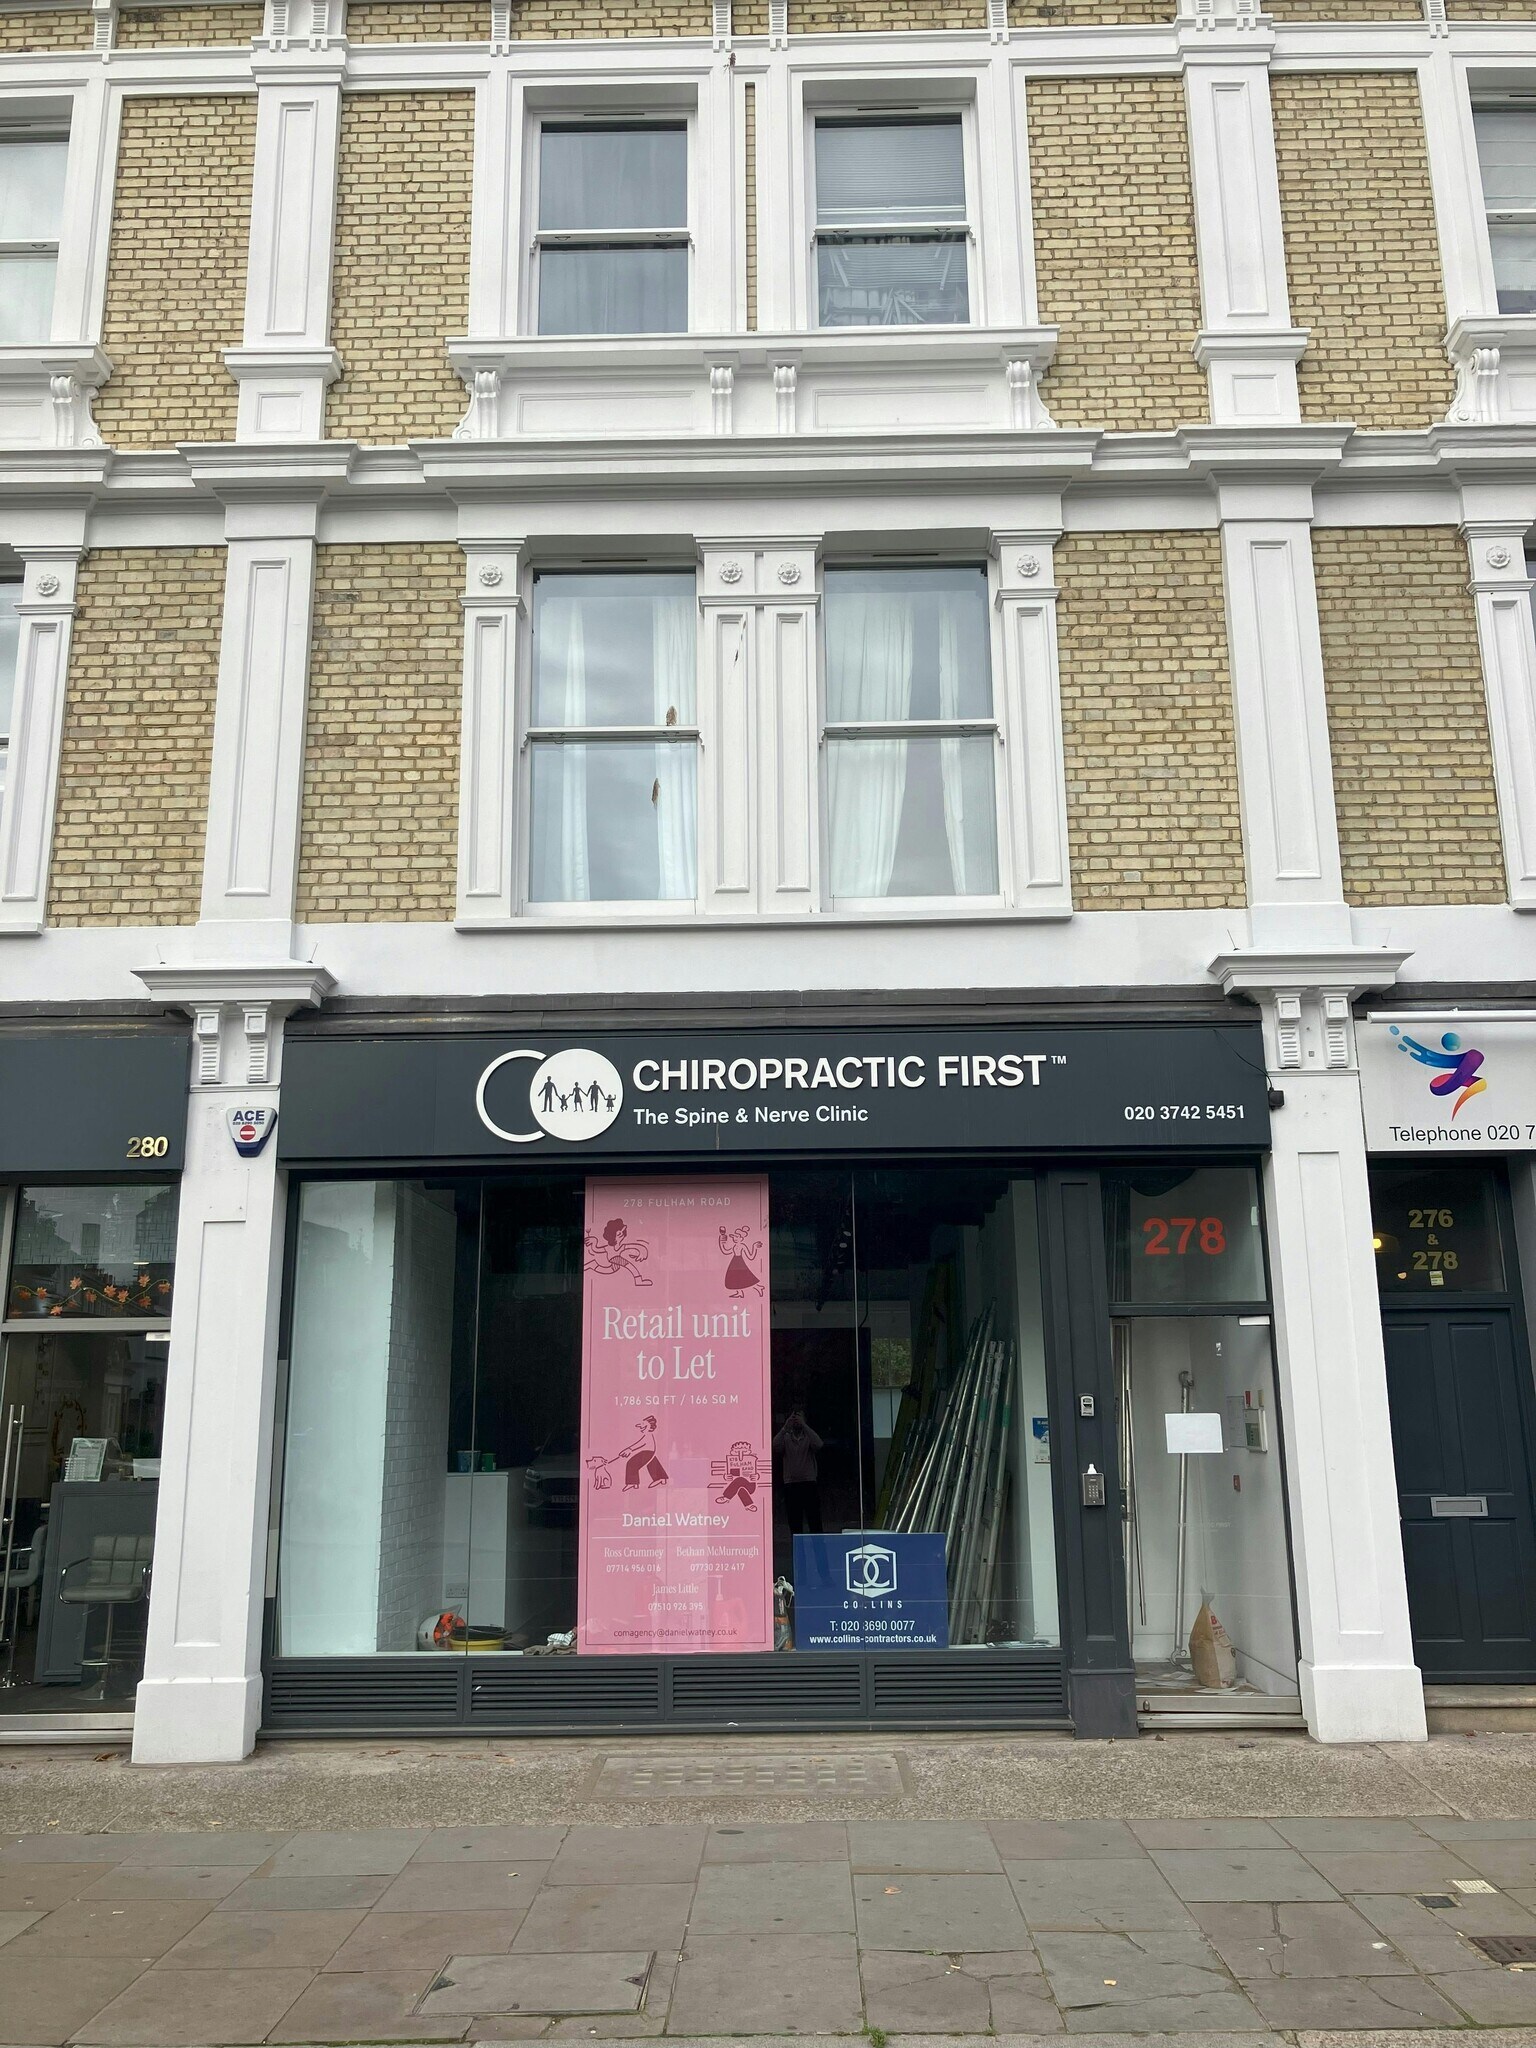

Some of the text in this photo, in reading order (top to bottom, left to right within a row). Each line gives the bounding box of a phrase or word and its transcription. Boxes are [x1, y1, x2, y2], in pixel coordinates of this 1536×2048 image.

[632, 1054, 927, 1092] CHIROPRACTIC
[233, 1110, 265, 1121] ACE
[633, 1105, 869, 1128] The Spine & Nerve Clinic
[1124, 1104, 1245, 1121] 020 3742 5451
[1389, 1125, 1482, 1145] Telephone
[1487, 1125, 1520, 1141] 020
[126, 1136, 169, 1159] 280
[623, 1197, 731, 1208] 278 FULHAM ROAD
[1408, 1209, 1454, 1229] 276
[1143, 1217, 1227, 1256] 278
[1427, 1233, 1440, 1246] &
[1412, 1251, 1459, 1271] 278
[602, 1304, 752, 1340] Retail unit
[636, 1346, 717, 1381] to Let
[614, 1394, 739, 1407] 1,786 SQ FT / 166 SQ M
[622, 1512, 729, 1529] Daniel Watney
[604, 1547, 665, 1560] Ross Crummey
[676, 1545, 759, 1559] Bethan McMurrough
[606, 1563, 629, 1573] 07714
[716, 1562, 729, 1572] 212
[730, 1562, 745, 1571] 417
[652, 1582, 699, 1596] James Little
[843, 1600, 903, 1609] COLINS
[829, 1620, 839, 1631] T:
[840, 1620, 860, 1631] 020
[889, 1620, 916, 1631] 0077
[613, 1627, 738, 1639] comagency@danielwatney.co.uk
